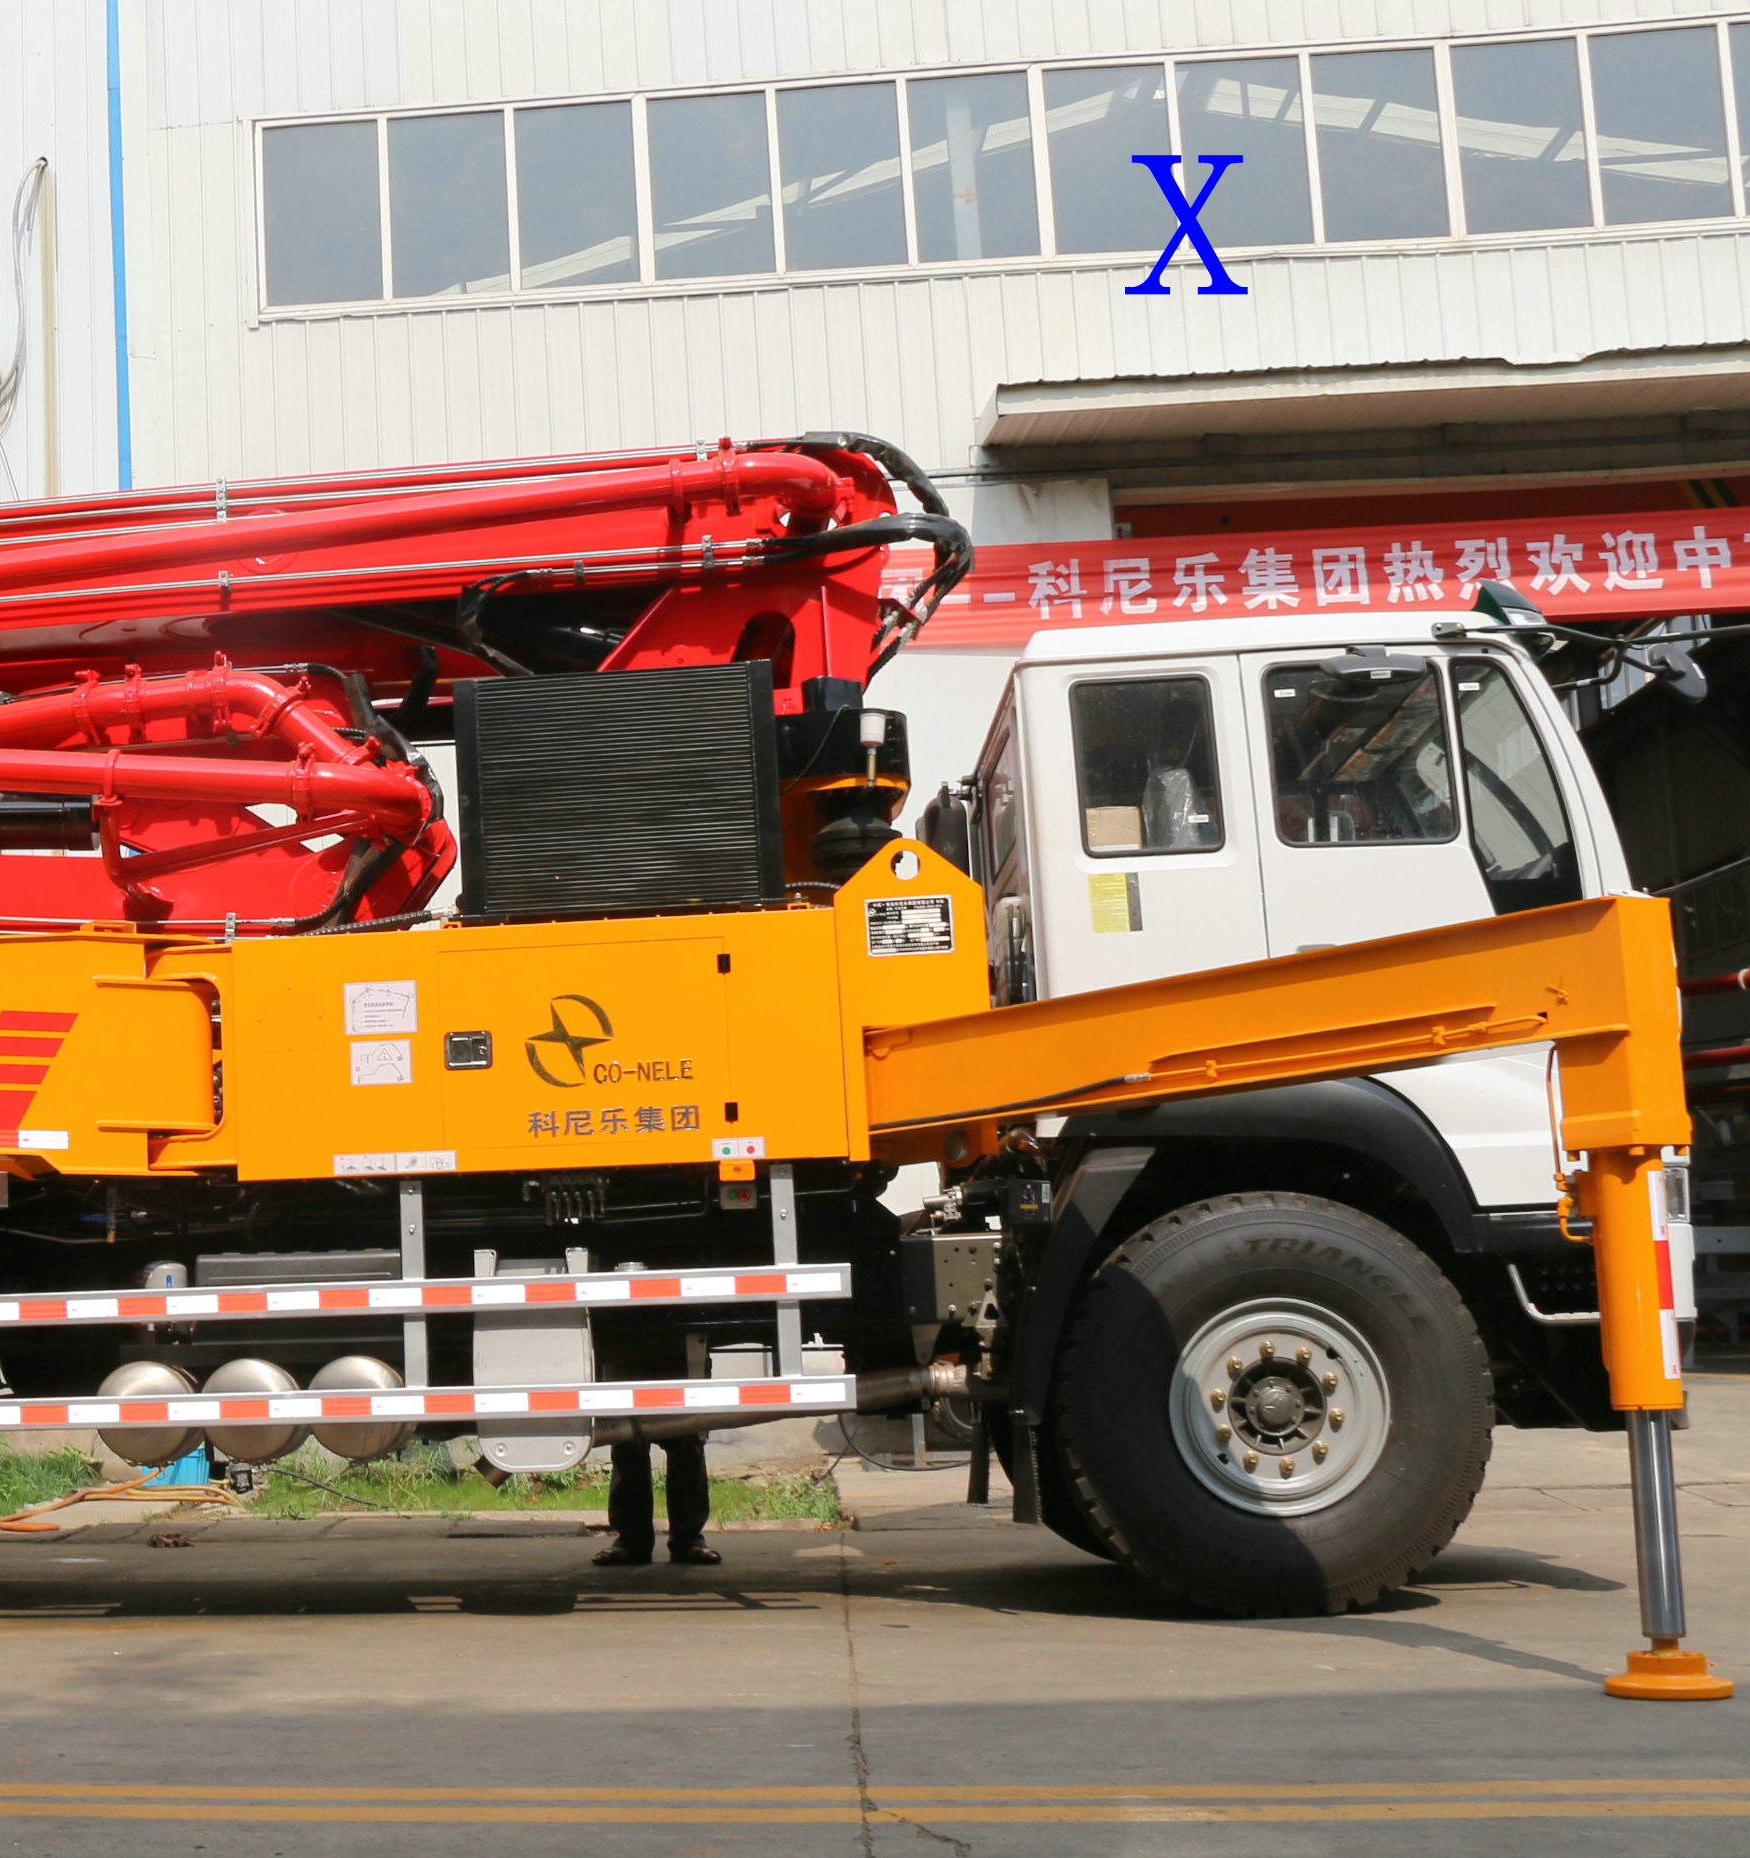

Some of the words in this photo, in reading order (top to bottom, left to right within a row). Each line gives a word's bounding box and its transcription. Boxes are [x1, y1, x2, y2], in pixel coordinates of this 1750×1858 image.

[527, 1104, 701, 1138] 科尼乐集团
